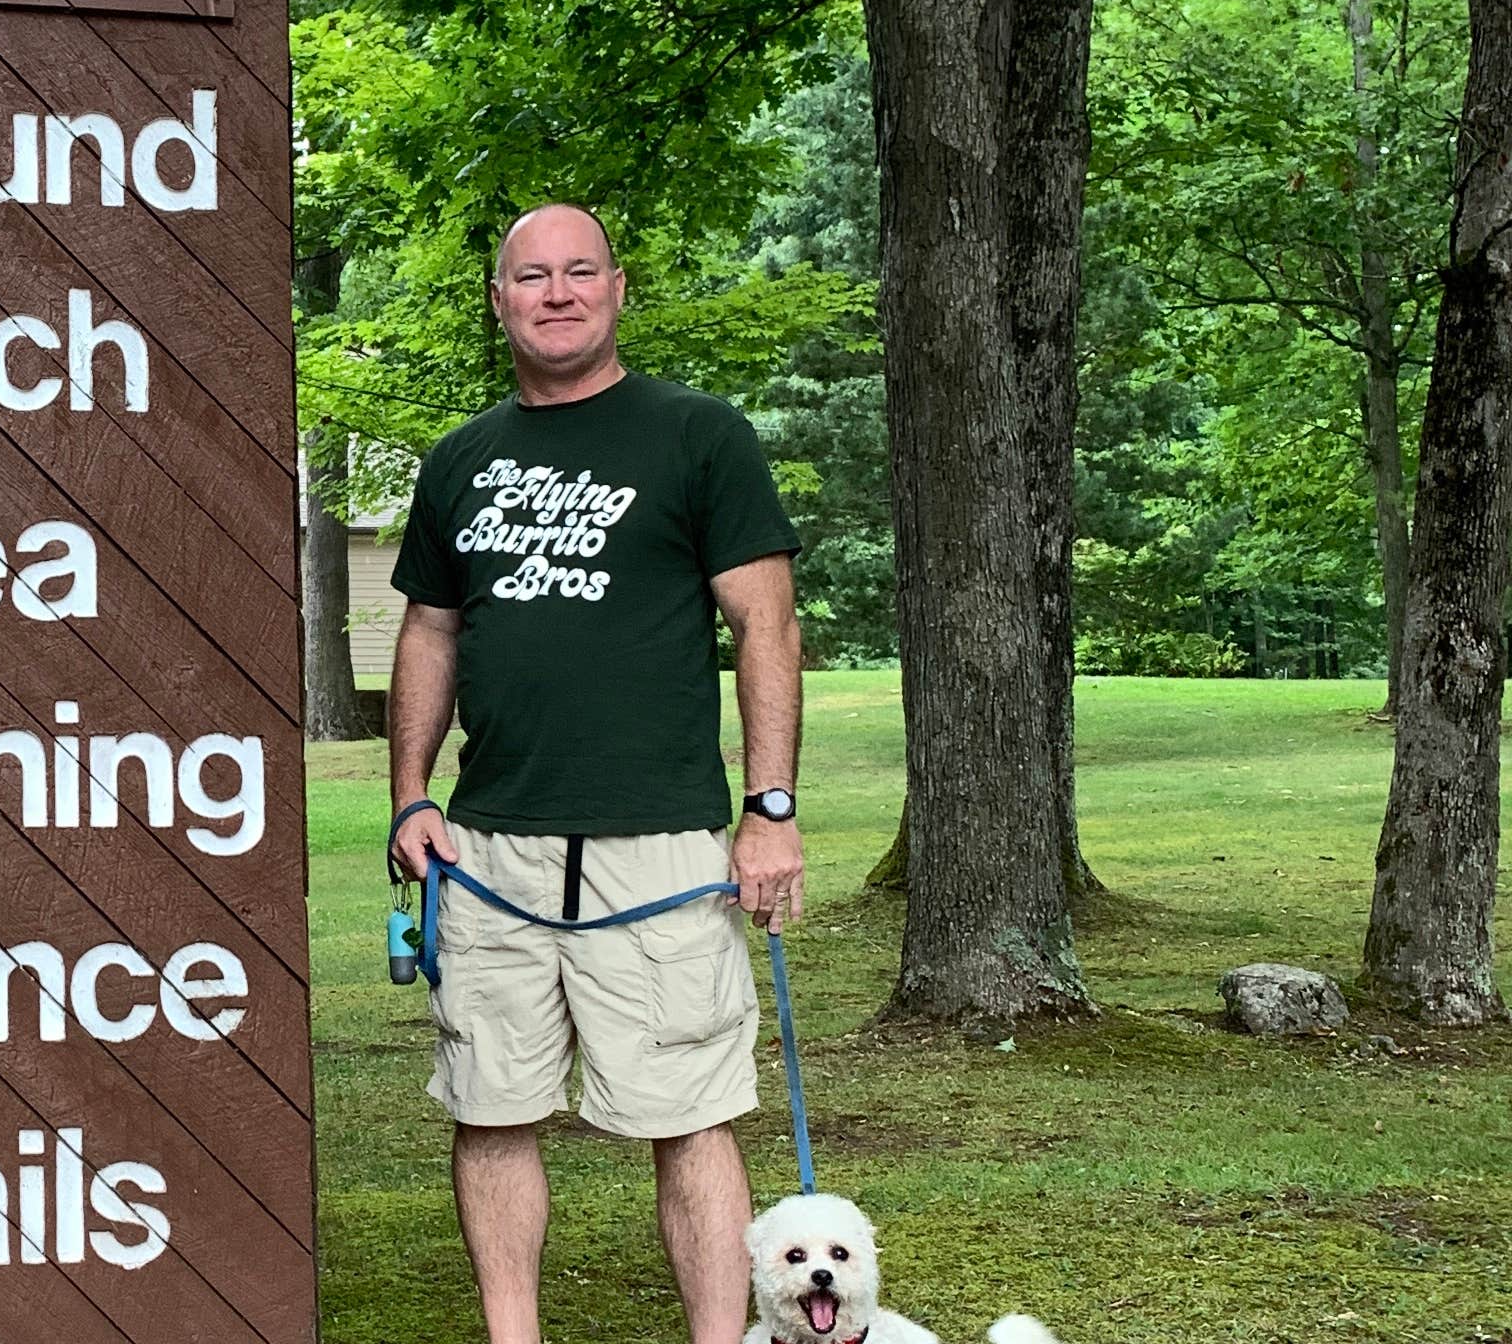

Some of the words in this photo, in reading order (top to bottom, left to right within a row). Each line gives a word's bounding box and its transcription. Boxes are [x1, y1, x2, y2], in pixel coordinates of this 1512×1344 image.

[472, 459, 523, 489] The
[493, 466, 637, 527] Flying
[455, 506, 607, 558] Burrito
[491, 554, 611, 602] Bros
